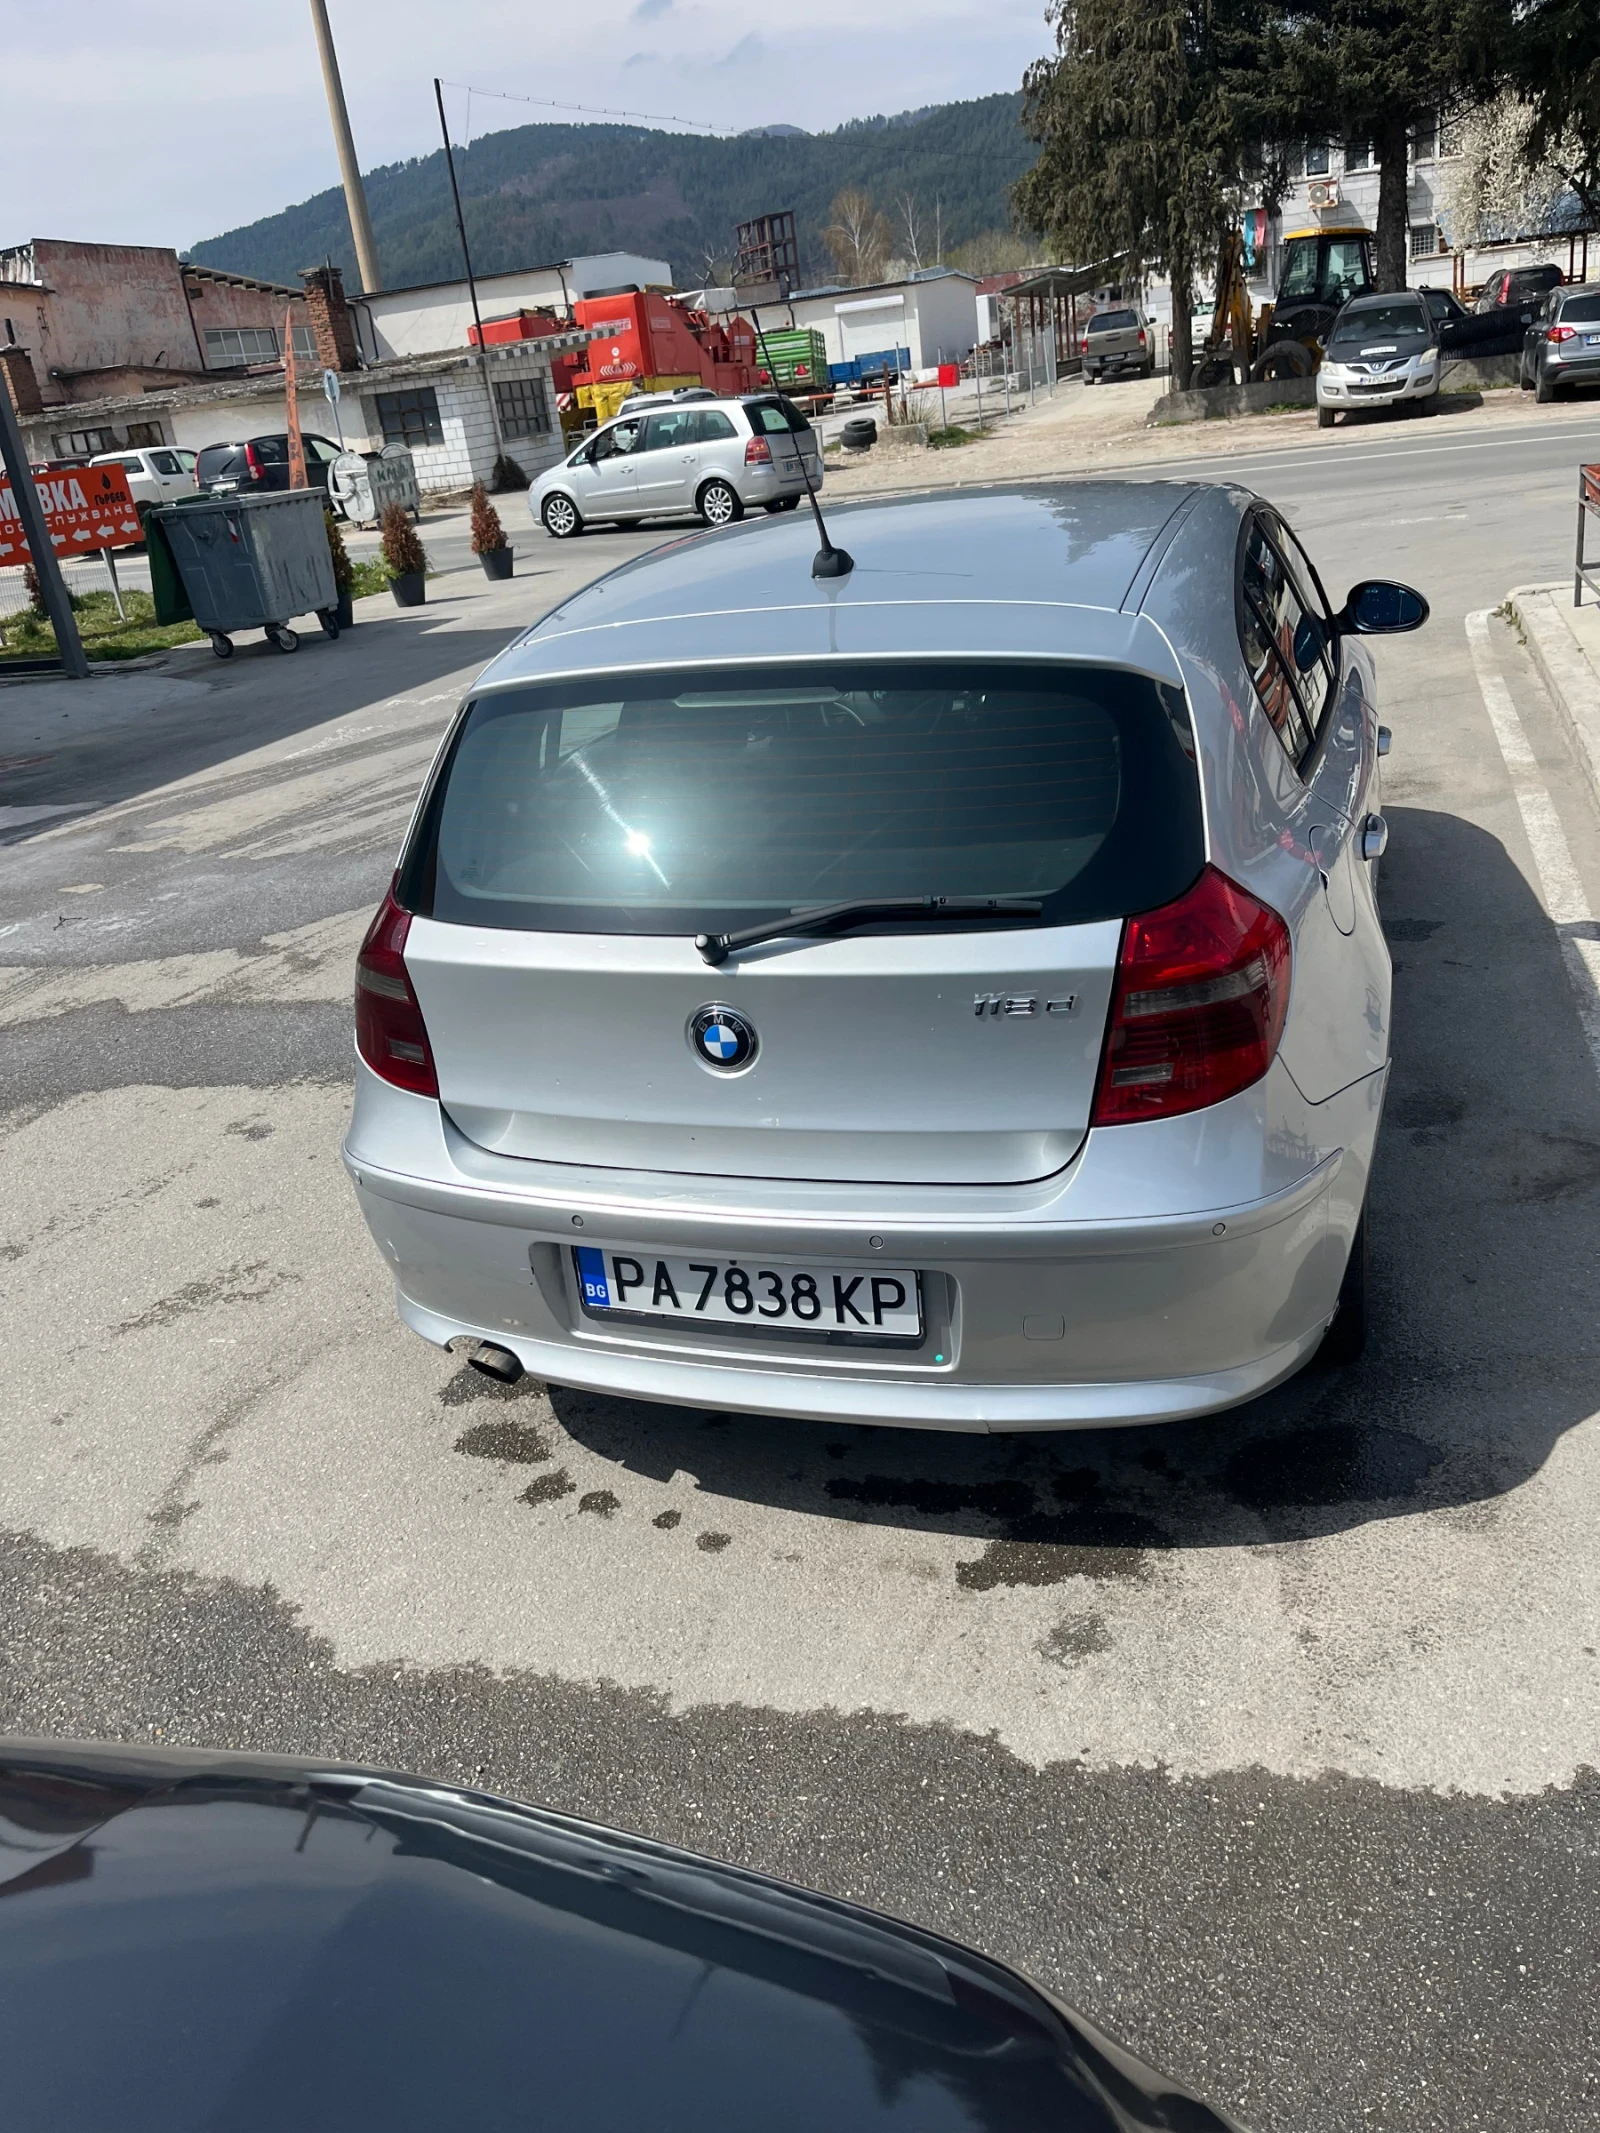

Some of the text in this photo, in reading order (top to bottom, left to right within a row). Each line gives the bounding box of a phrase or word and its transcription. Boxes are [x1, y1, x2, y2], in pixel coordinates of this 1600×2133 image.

[0, 478, 88, 521] МВКА
[698, 1014, 743, 1033] BMW
[585, 1282, 607, 1299] BG
